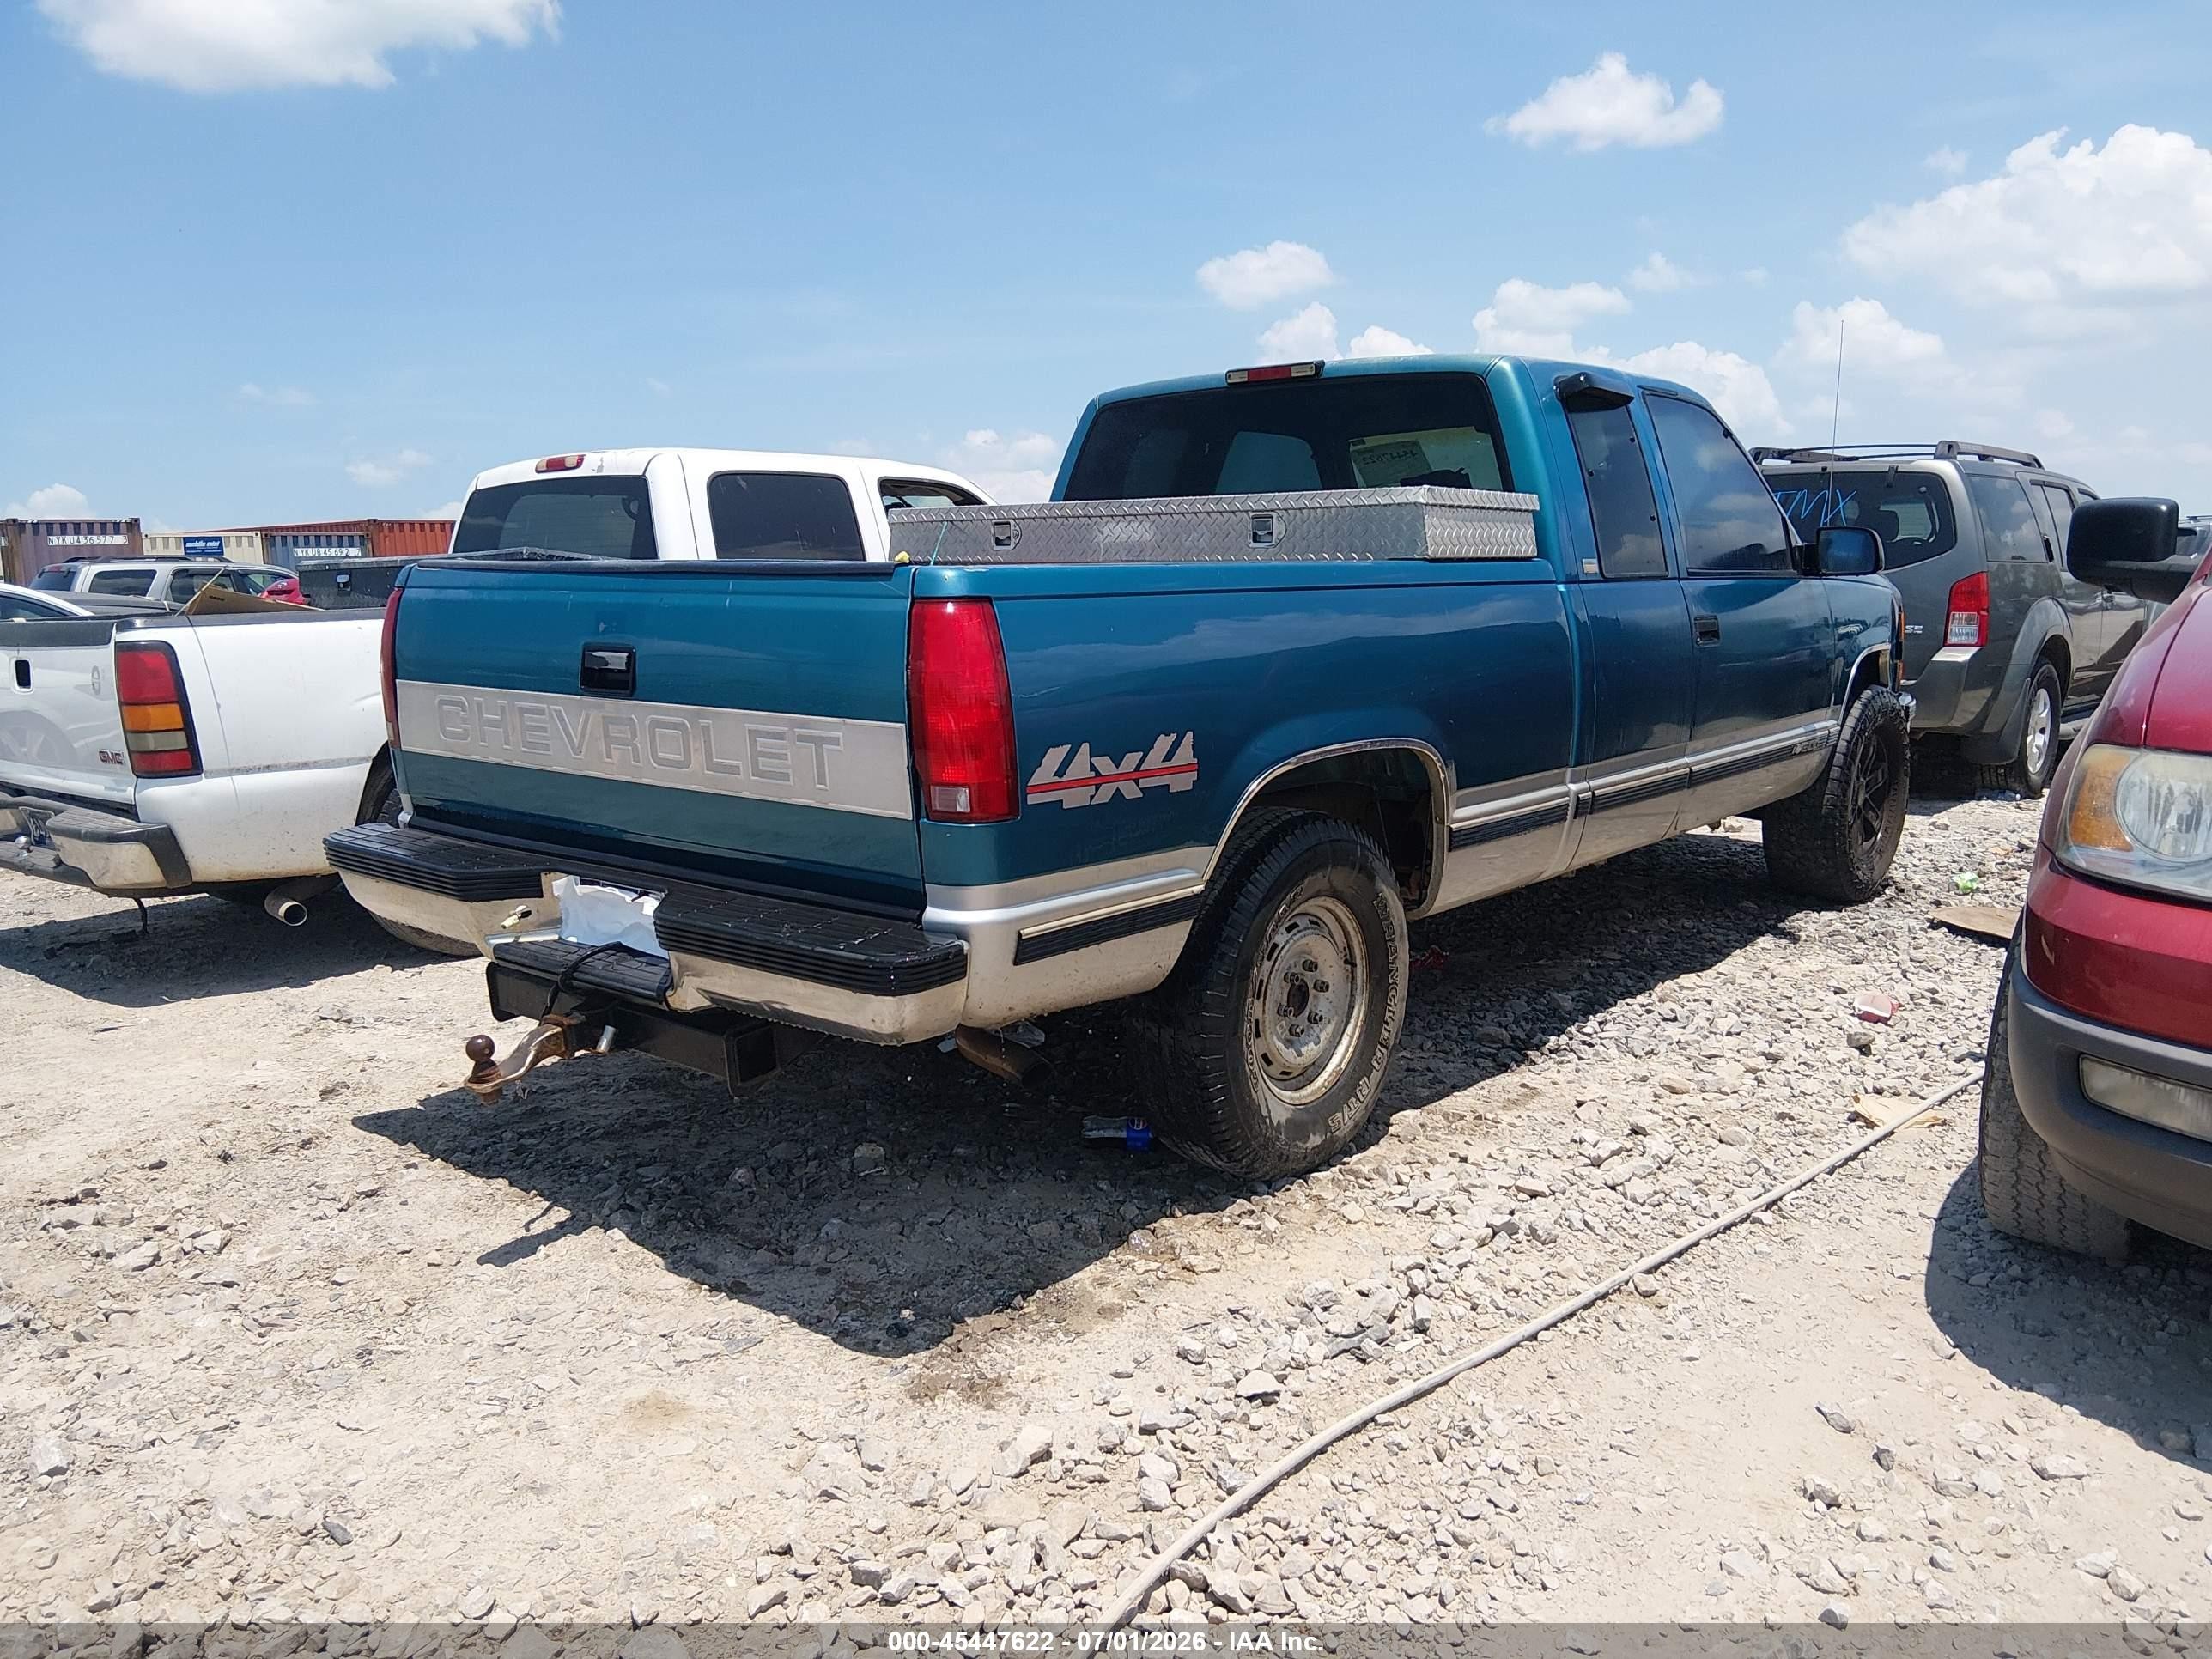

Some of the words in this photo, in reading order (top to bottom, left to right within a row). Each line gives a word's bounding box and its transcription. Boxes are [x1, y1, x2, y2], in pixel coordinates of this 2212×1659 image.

[1904, 624, 1923, 634] SE
[98, 750, 124, 765] GMC
[435, 694, 843, 791] CHEVROLET
[1371, 892, 1399, 1072] WRANGLER
